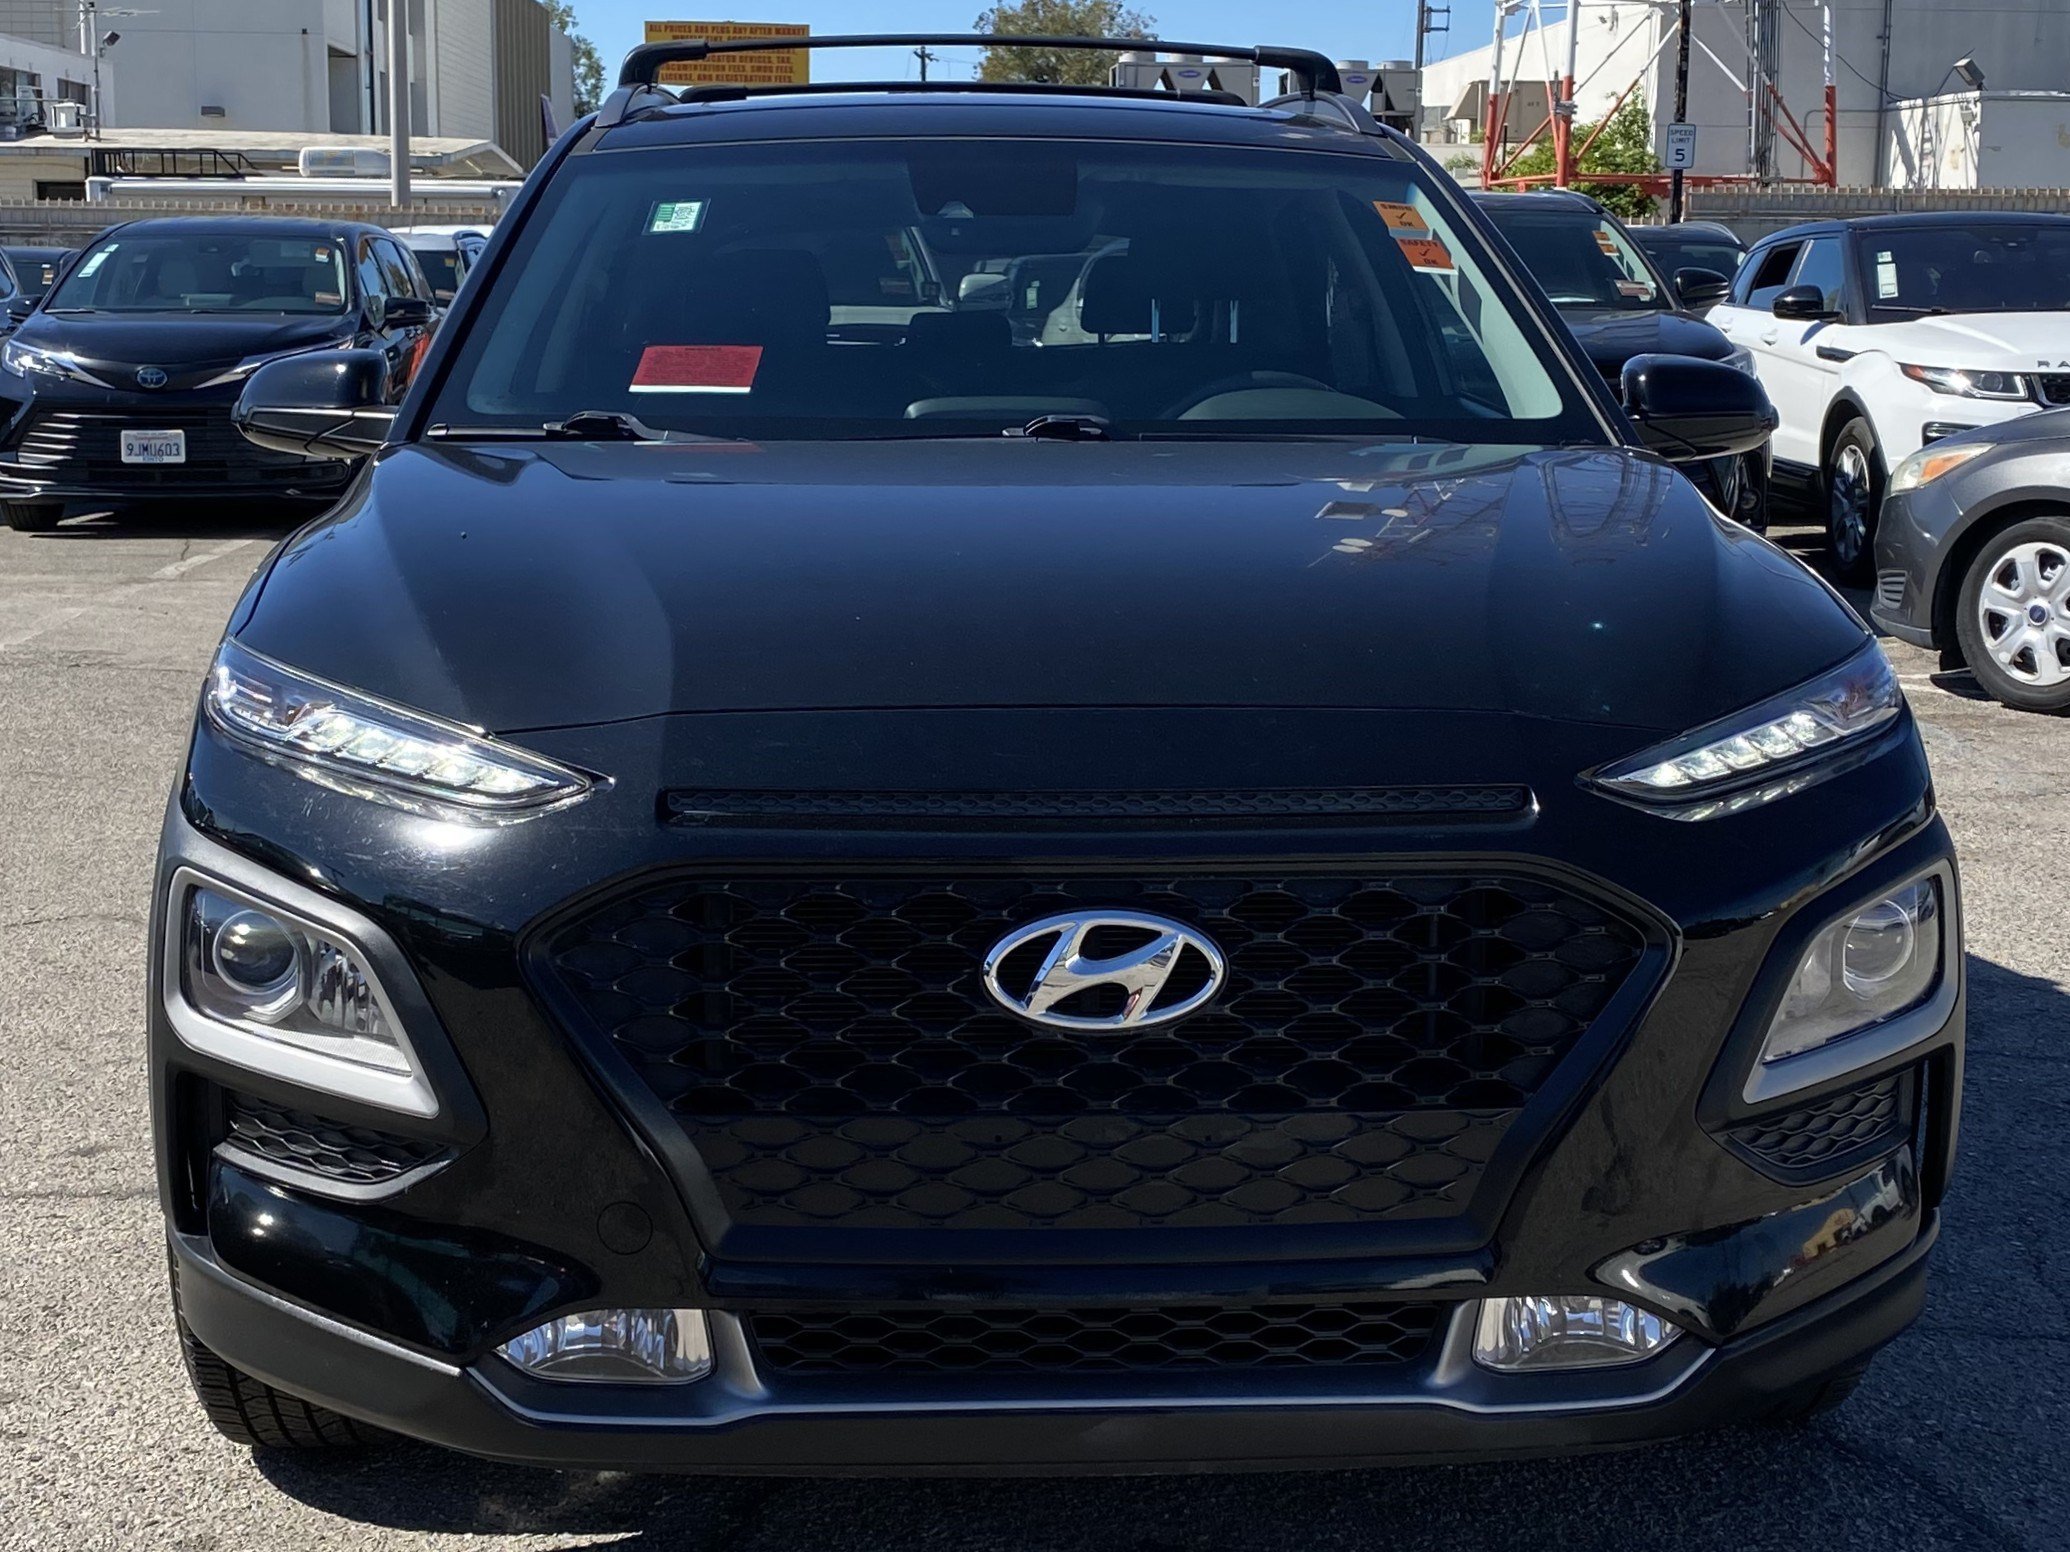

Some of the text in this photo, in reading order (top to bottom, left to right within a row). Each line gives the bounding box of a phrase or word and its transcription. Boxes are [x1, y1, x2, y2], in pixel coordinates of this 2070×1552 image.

[649, 24, 805, 35] ALL PRICES ARE PLUS ANY AFTER MARKET
[697, 73, 713, 82] AND
[715, 74, 773, 83] REGISTRATION
[1674, 148, 1685, 162] 5
[1400, 239, 1438, 247] SAFETY
[126, 443, 180, 457] 9JMU603
